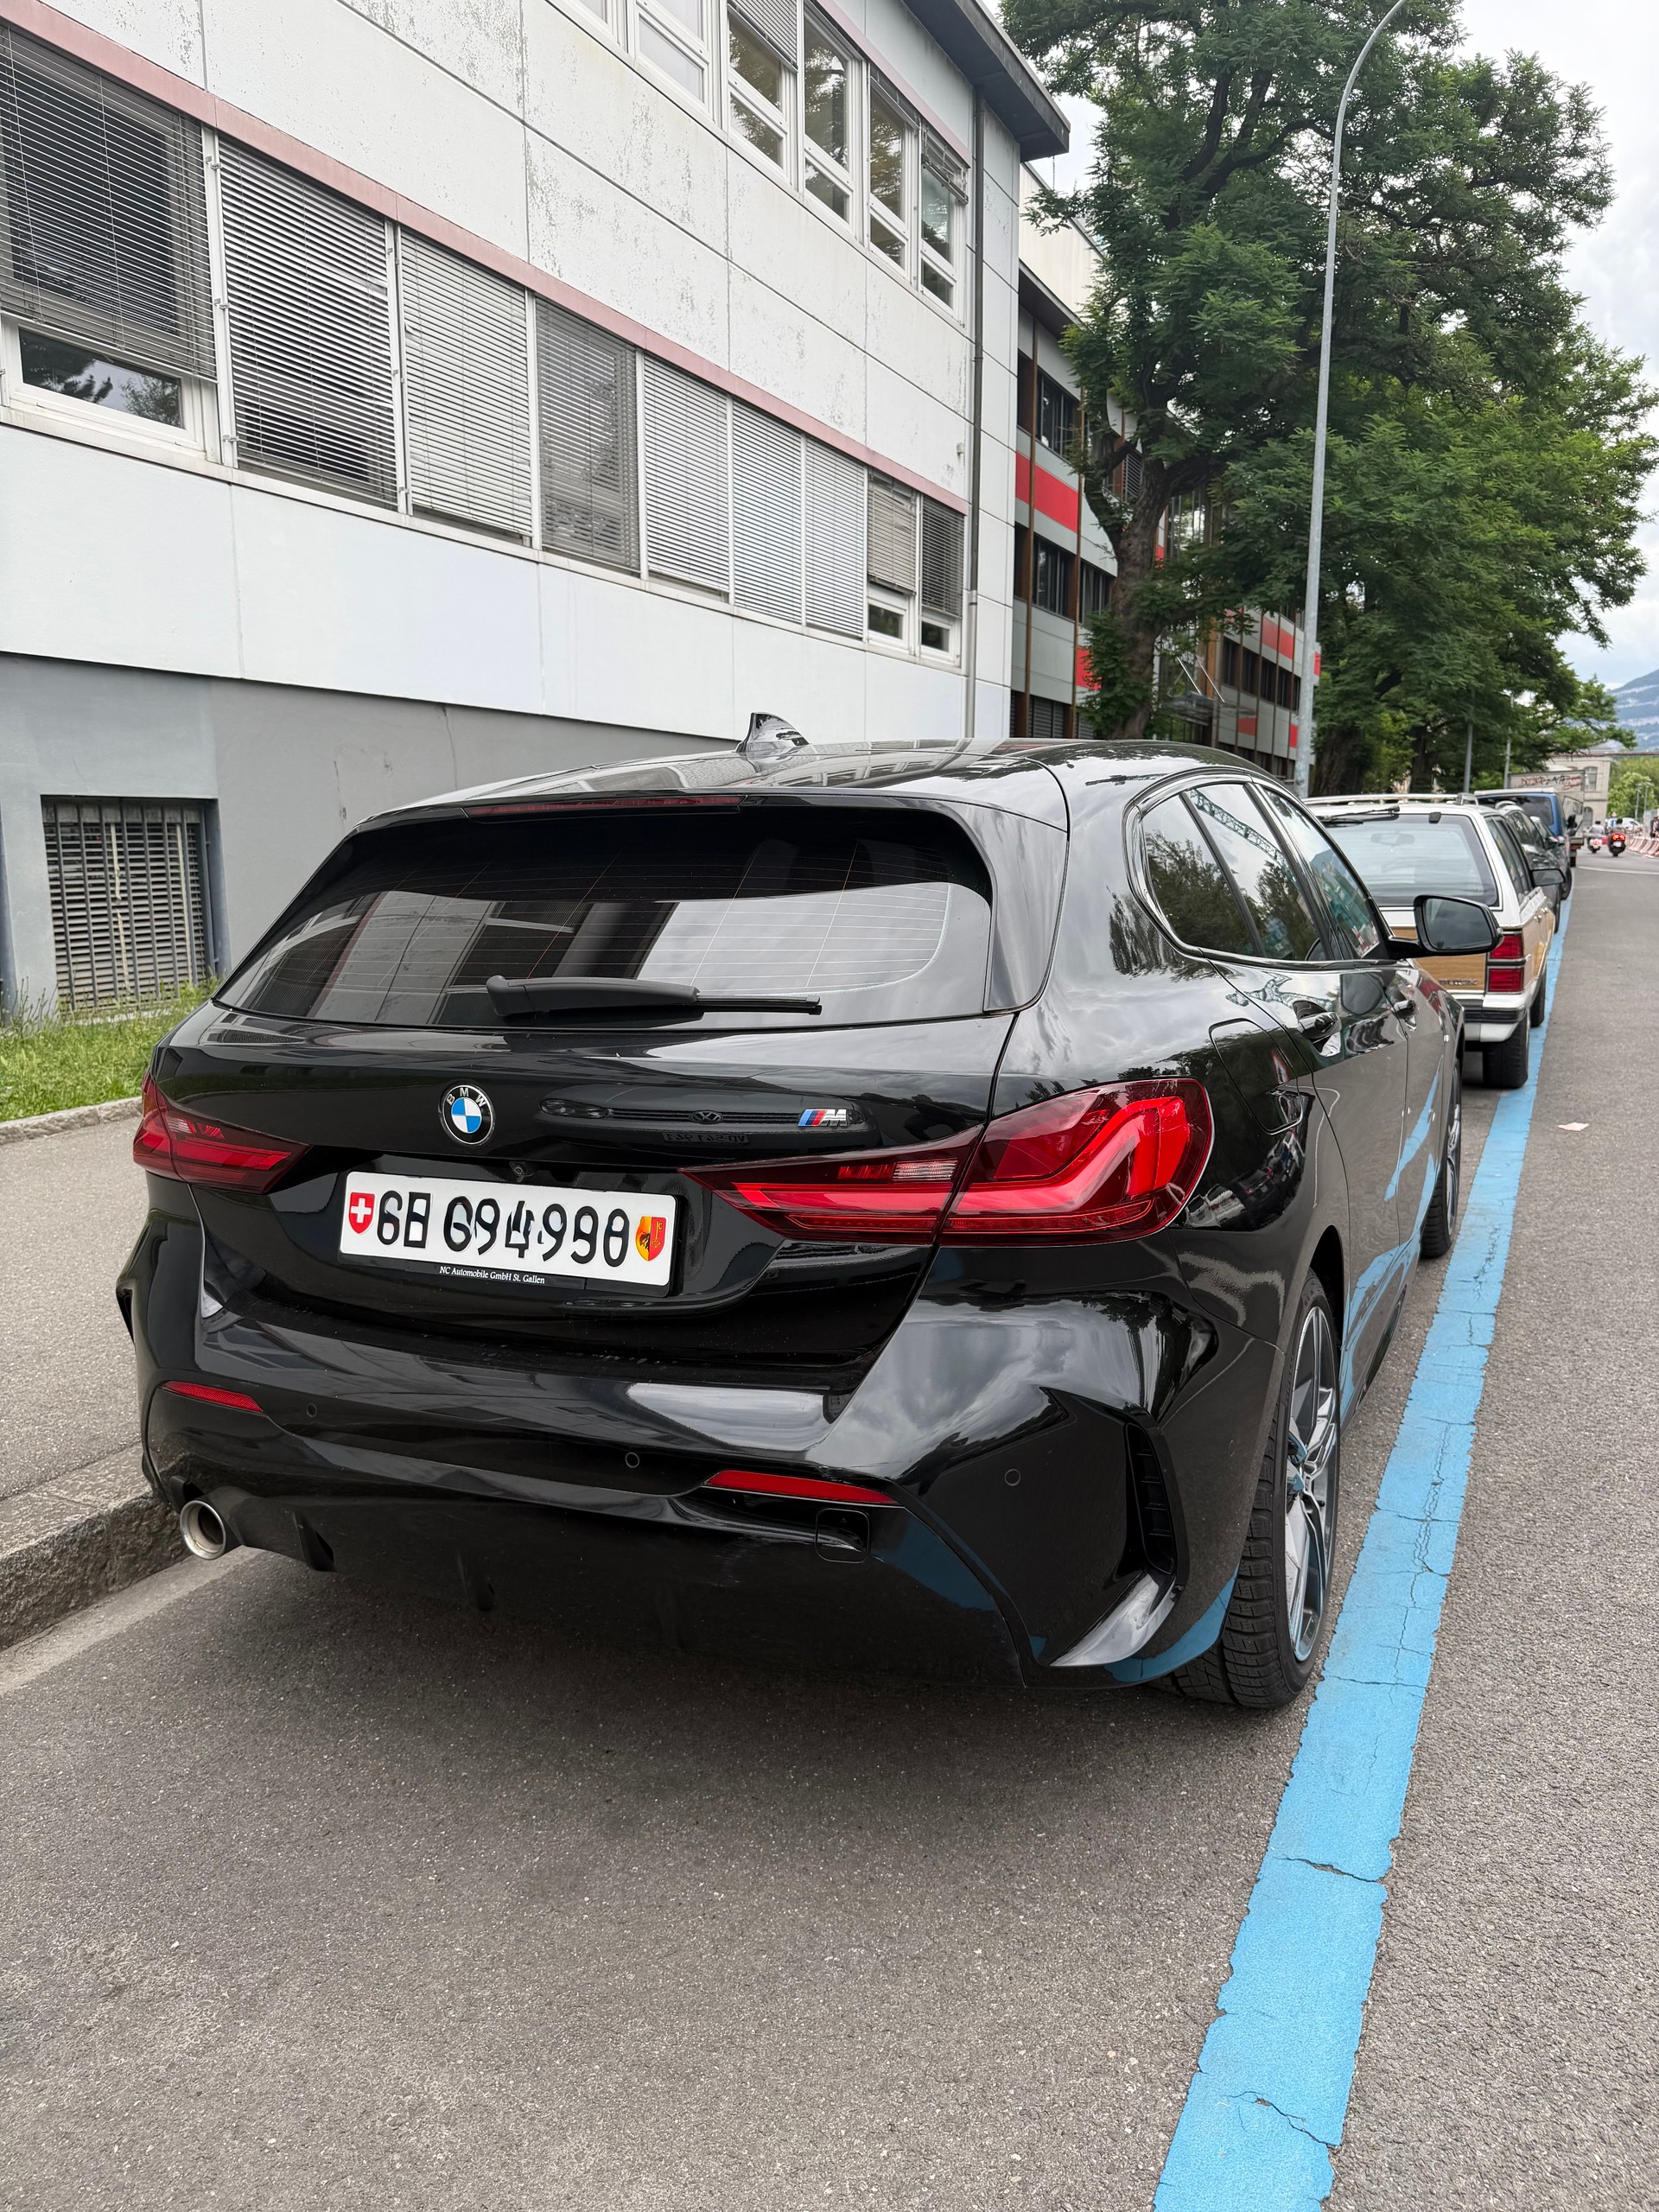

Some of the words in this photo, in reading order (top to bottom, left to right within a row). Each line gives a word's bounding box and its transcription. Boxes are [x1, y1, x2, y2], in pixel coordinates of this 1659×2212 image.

[446, 1087, 486, 1107] BMW
[439, 1266, 450, 1274] NC
[451, 1267, 489, 1279] Automobile
[490, 1271, 512, 1281] GmbH
[512, 1274, 521, 1282] St.
[523, 1274, 545, 1284] Gallen
